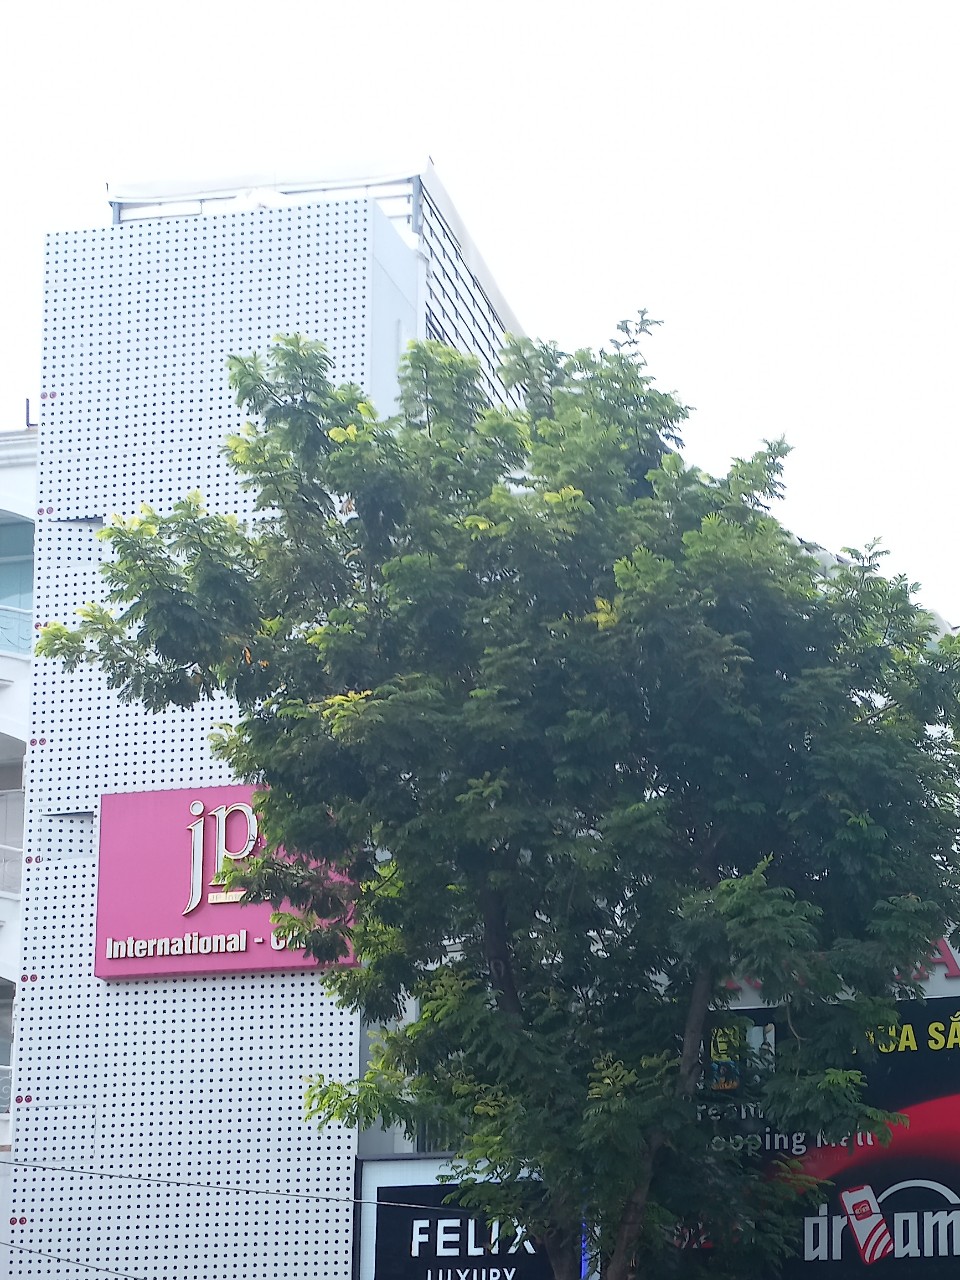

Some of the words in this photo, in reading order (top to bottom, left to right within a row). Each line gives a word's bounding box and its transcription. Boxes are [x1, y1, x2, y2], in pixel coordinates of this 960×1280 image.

[106, 929, 248, 960] International
[852, 1022, 918, 1055] UA
[410, 1217, 537, 1258] FELIX
